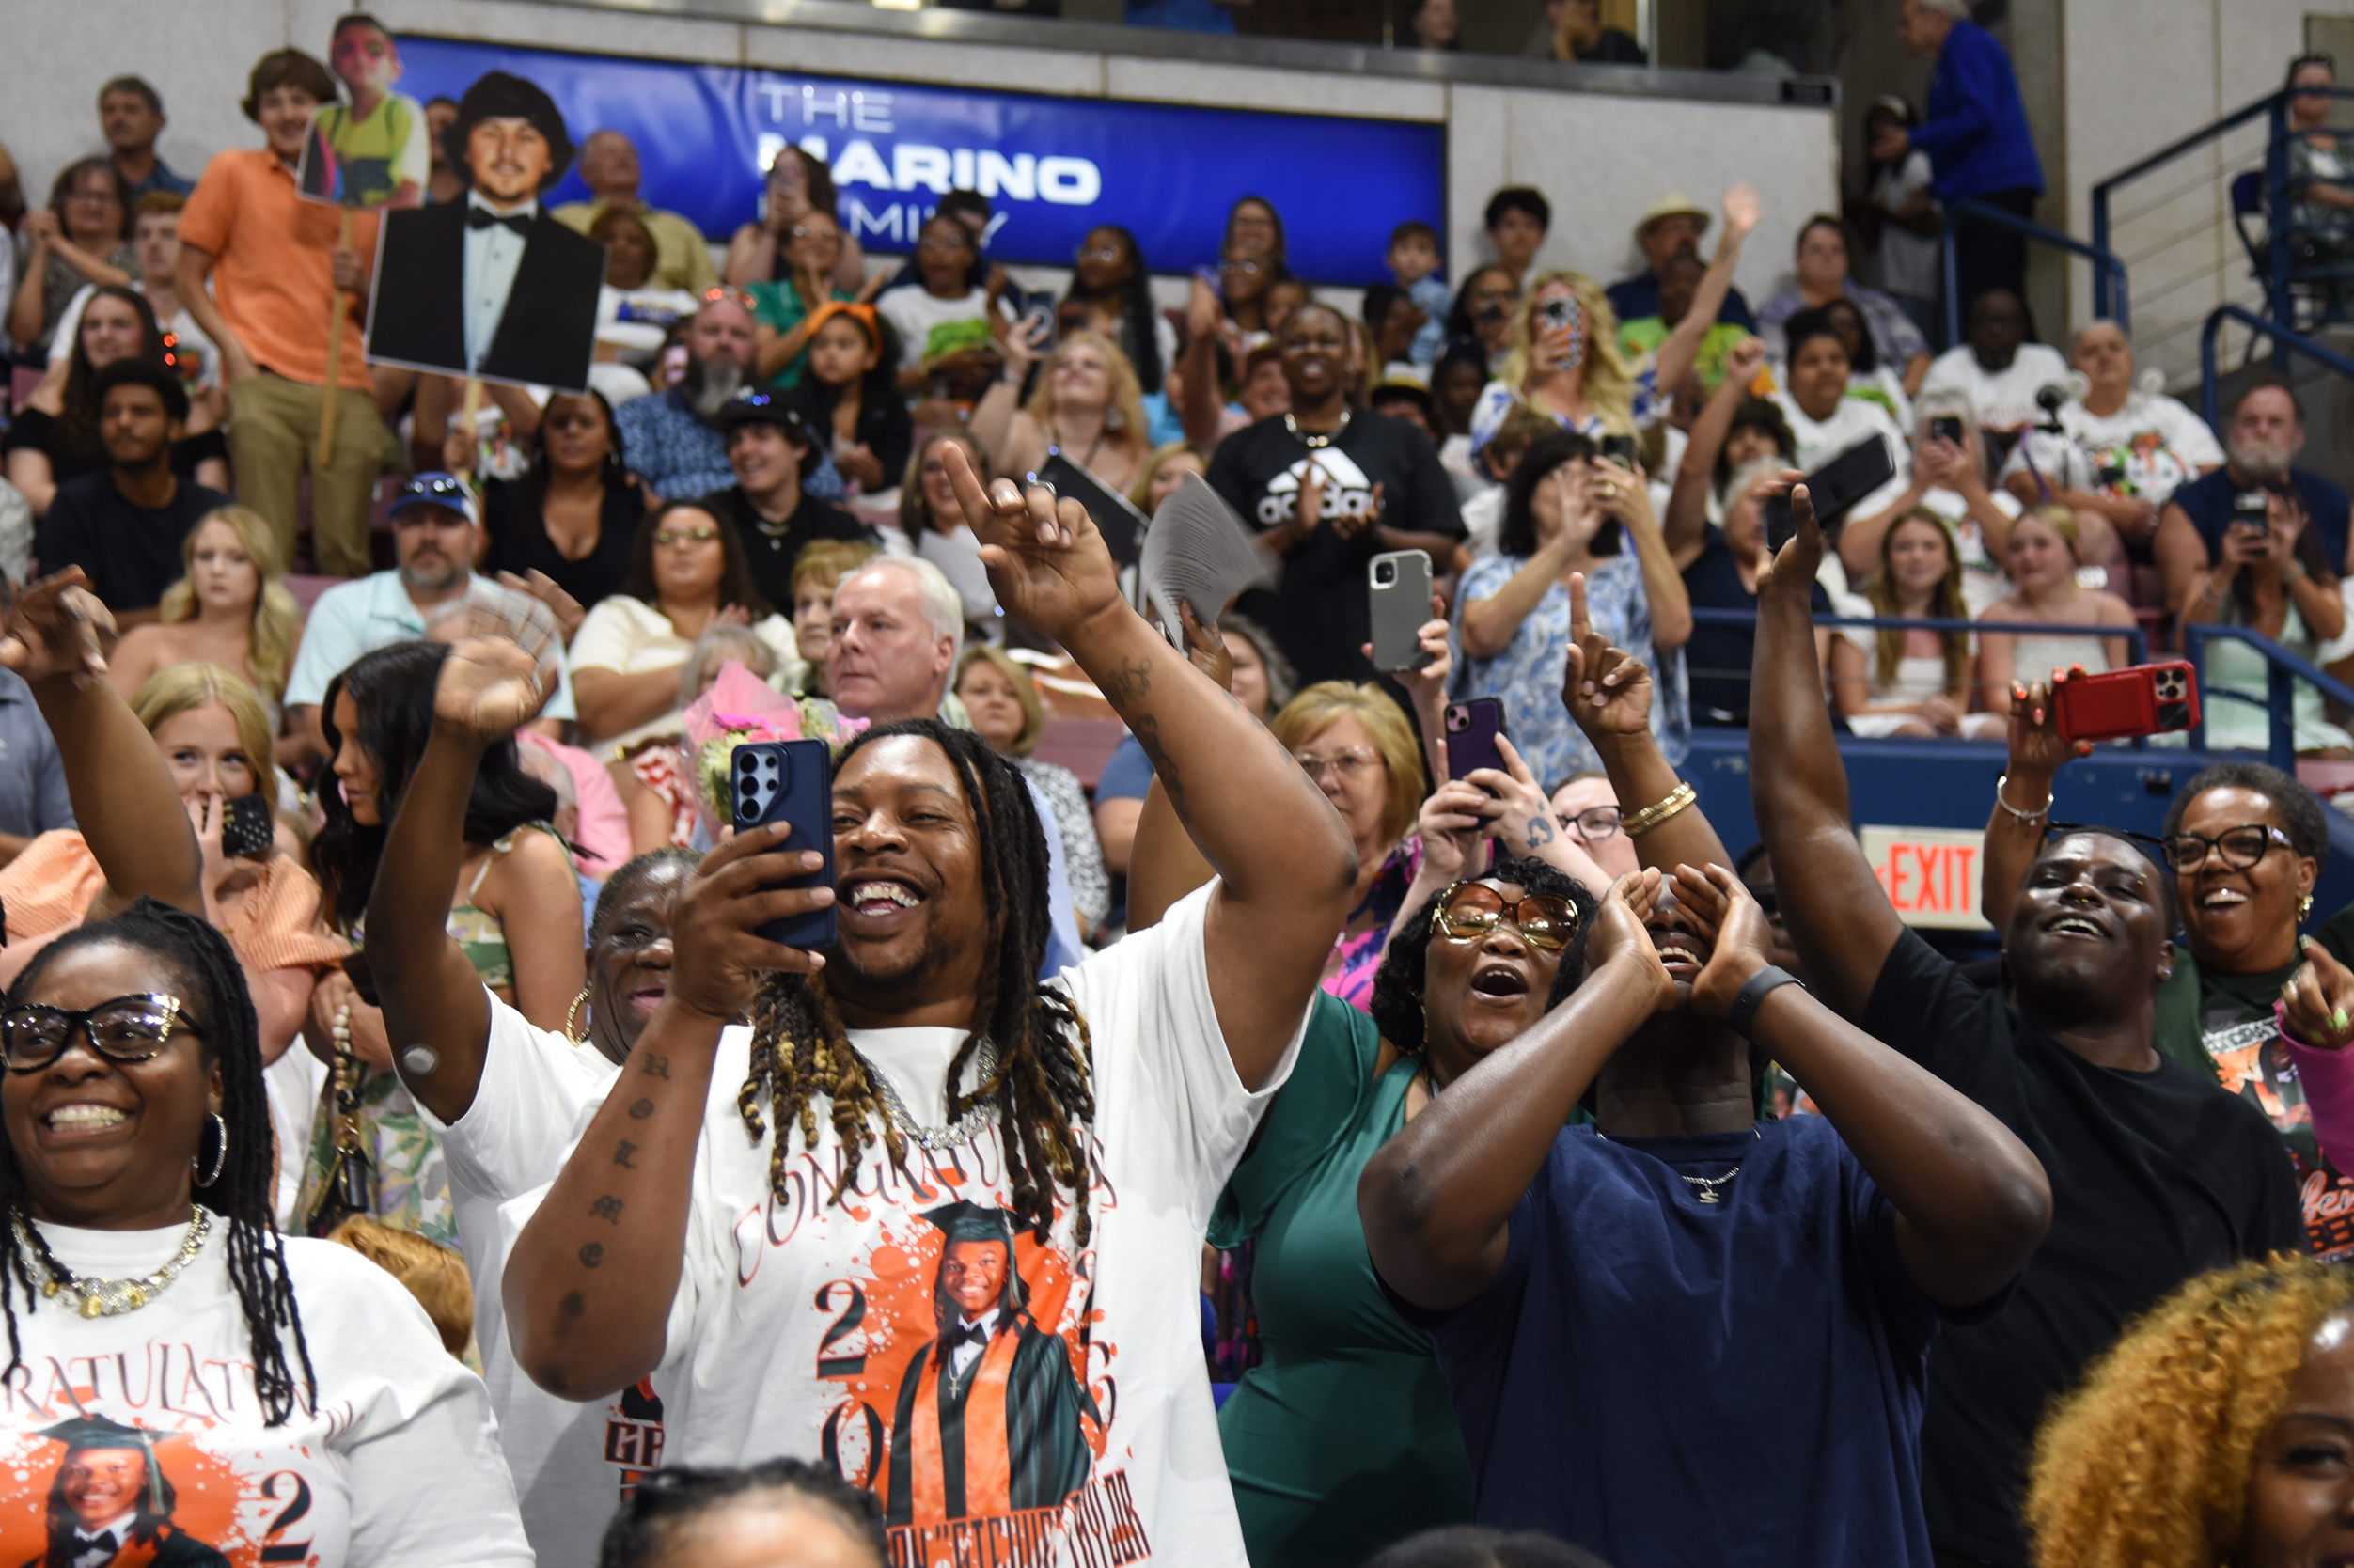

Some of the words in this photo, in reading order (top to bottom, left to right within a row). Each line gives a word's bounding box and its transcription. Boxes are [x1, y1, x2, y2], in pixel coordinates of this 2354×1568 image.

[757, 80, 896, 133] THE
[1888, 842, 1977, 915] EXIT
[814, 1278, 867, 1381] 2
[259, 1468, 313, 1564] 2
